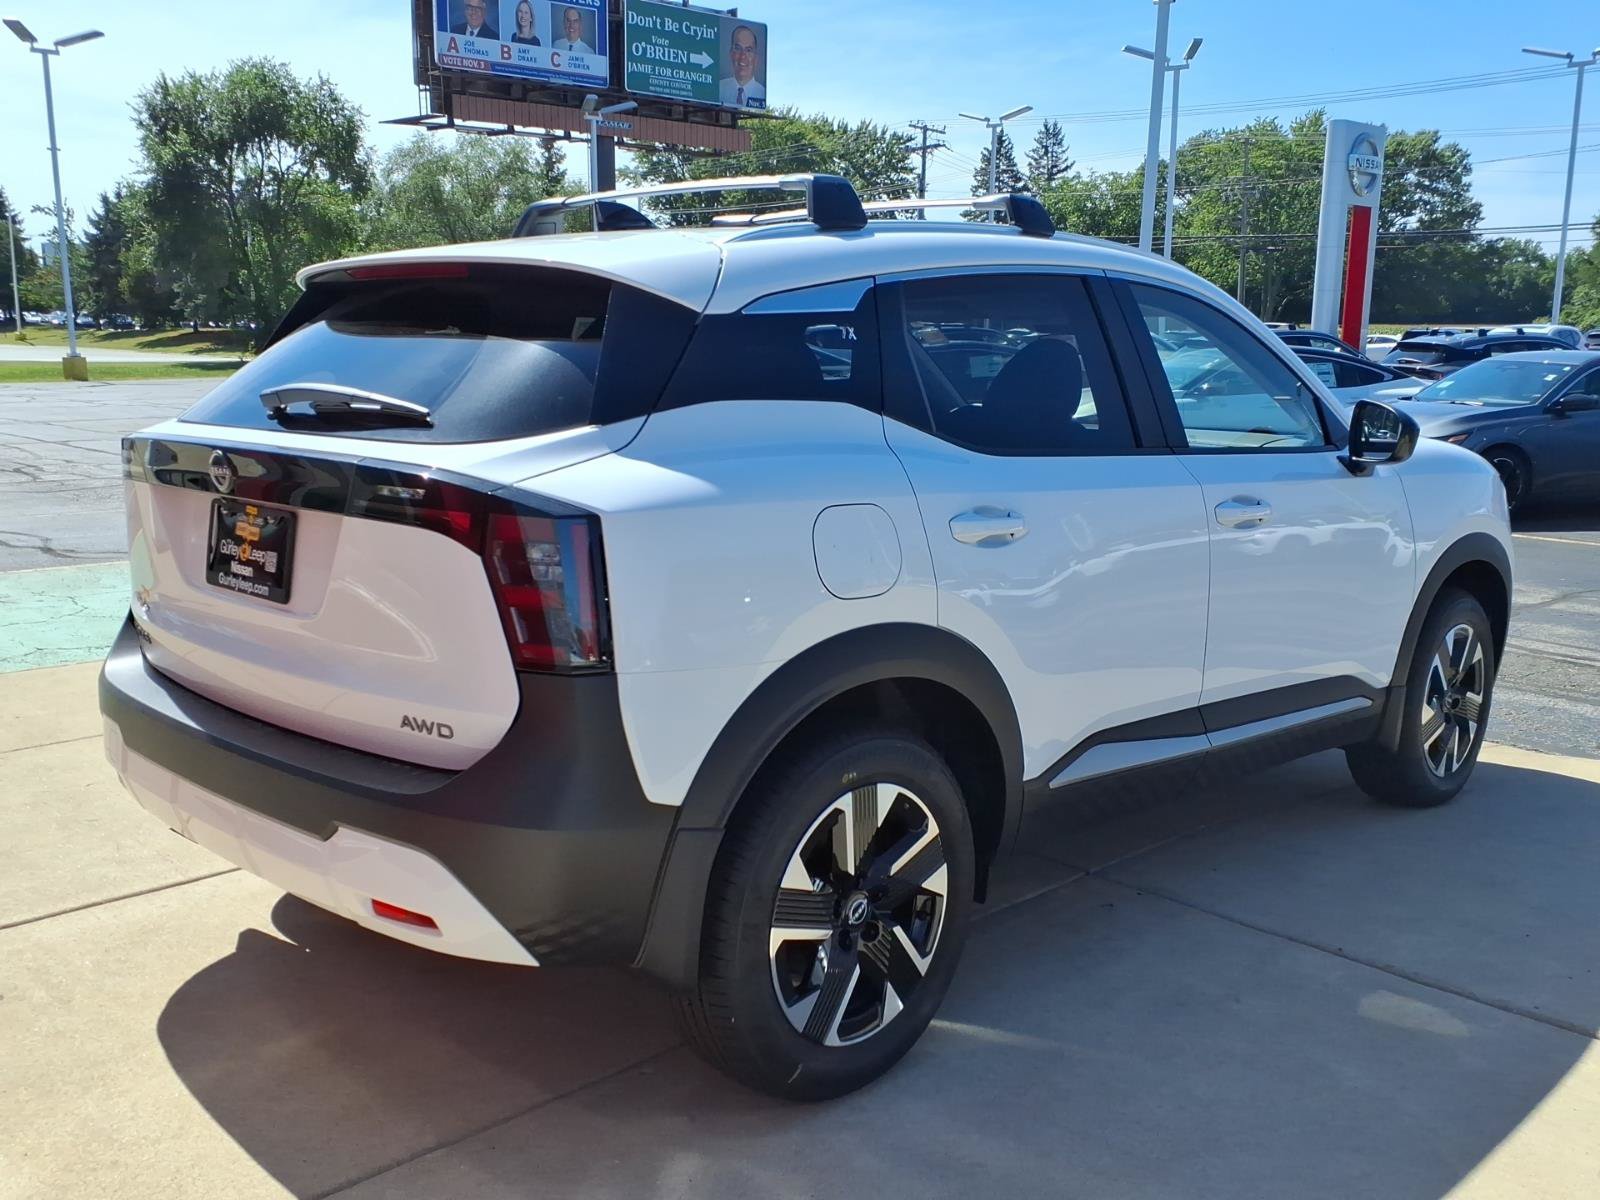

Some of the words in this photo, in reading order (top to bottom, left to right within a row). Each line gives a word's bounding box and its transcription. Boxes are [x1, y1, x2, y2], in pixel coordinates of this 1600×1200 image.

[627, 11, 661, 30] Don't
[664, 17, 680, 33] Be
[682, 21, 718, 40] Cryin'
[447, 36, 459, 54] A
[464, 39, 475, 48] JOE
[652, 35, 670, 47] Vote
[464, 46, 489, 57] THOMAS
[500, 44, 512, 61] B
[517, 48, 530, 56] AMY
[517, 54, 537, 64] DRAKE
[632, 41, 687, 64] O'BRIEN
[442, 55, 462, 66] VOTE
[463, 58, 479, 68] NOV.
[551, 51, 561, 68] C
[568, 55, 585, 64] JAMIE
[568, 62, 590, 72] O'BRIEN
[628, 61, 654, 74] JAMIE
[655, 65, 672, 77] FOR
[673, 66, 713, 84] GRANGER
[1355, 157, 1379, 170] NISSA
[220, 539, 240, 560] Gurley
[230, 560, 254, 577] Nissan
[400, 714, 454, 739] AWD
